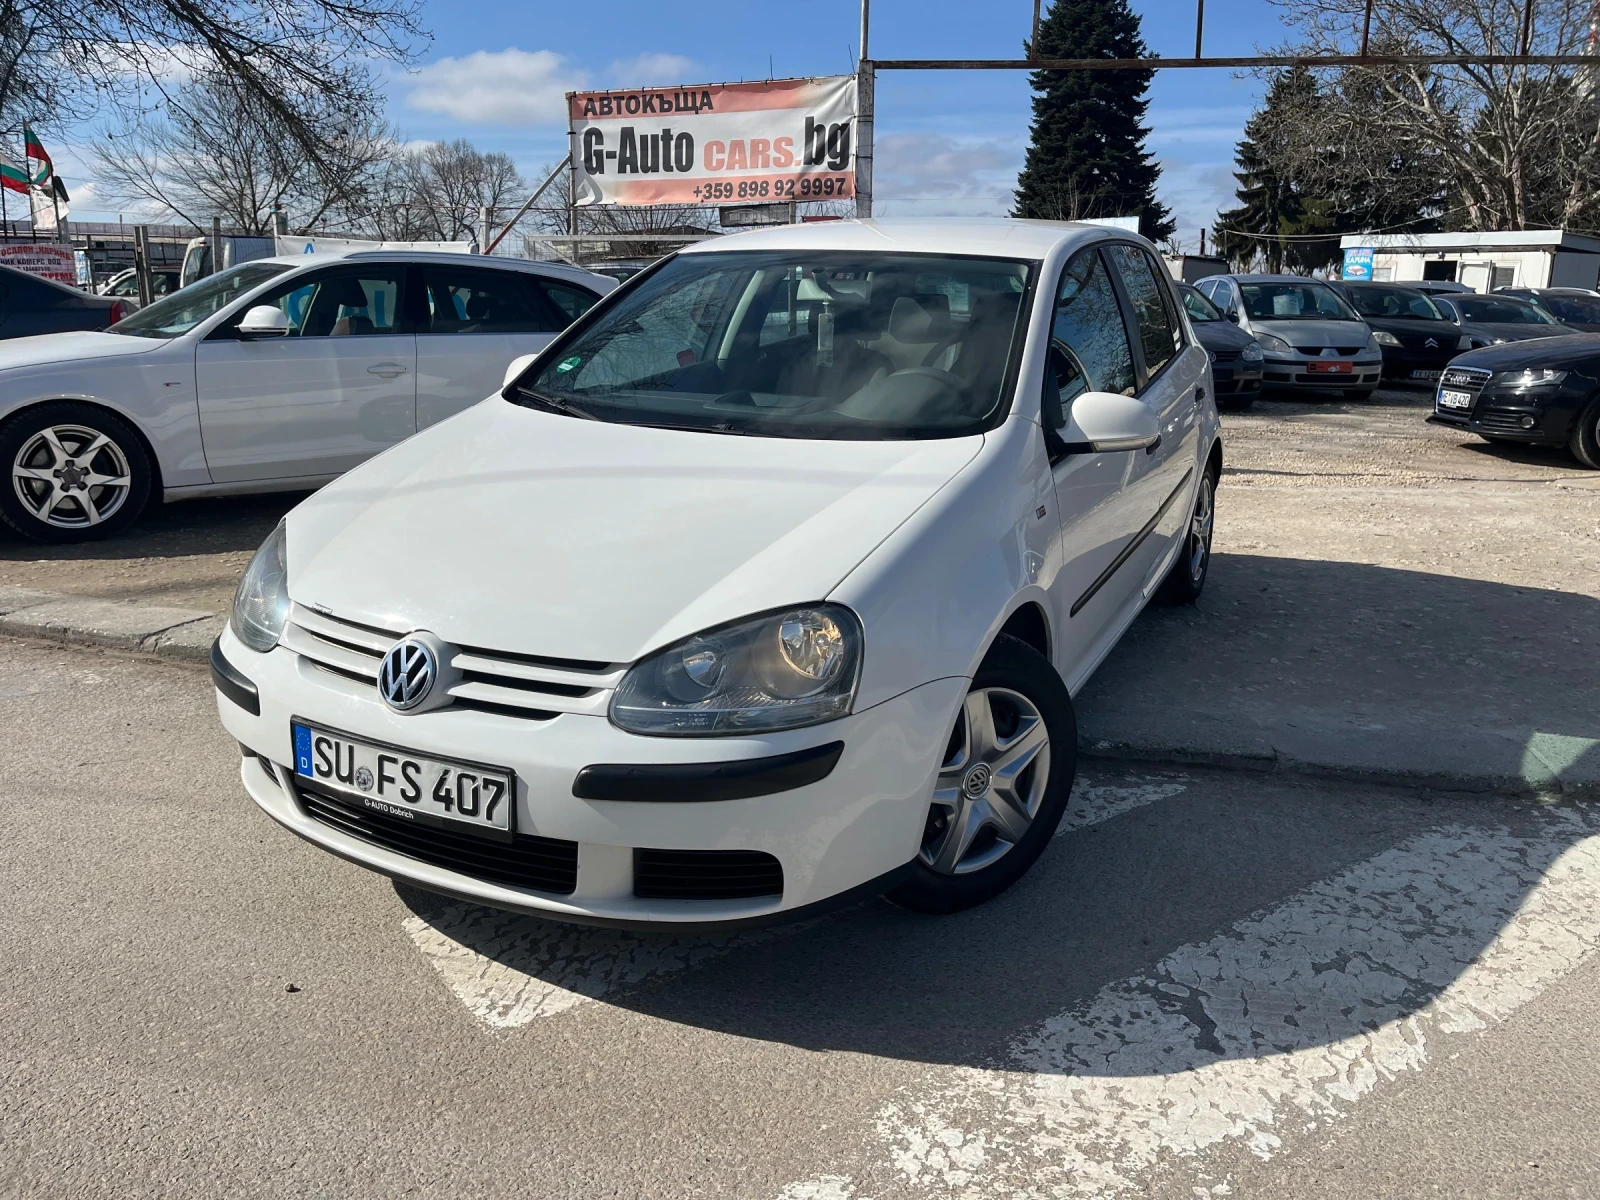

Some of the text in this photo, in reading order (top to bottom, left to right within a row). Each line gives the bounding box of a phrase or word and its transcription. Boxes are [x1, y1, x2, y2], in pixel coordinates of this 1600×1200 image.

[583, 90, 714, 116] АВТОКЪЩА
[583, 126, 695, 175] G-Auto
[693, 177, 846, 200] +359 898 92 9997
[301, 757, 308, 769] D
[314, 736, 505, 822] SU FS 407
[364, 799, 414, 819] G-AUTO Dobrich
